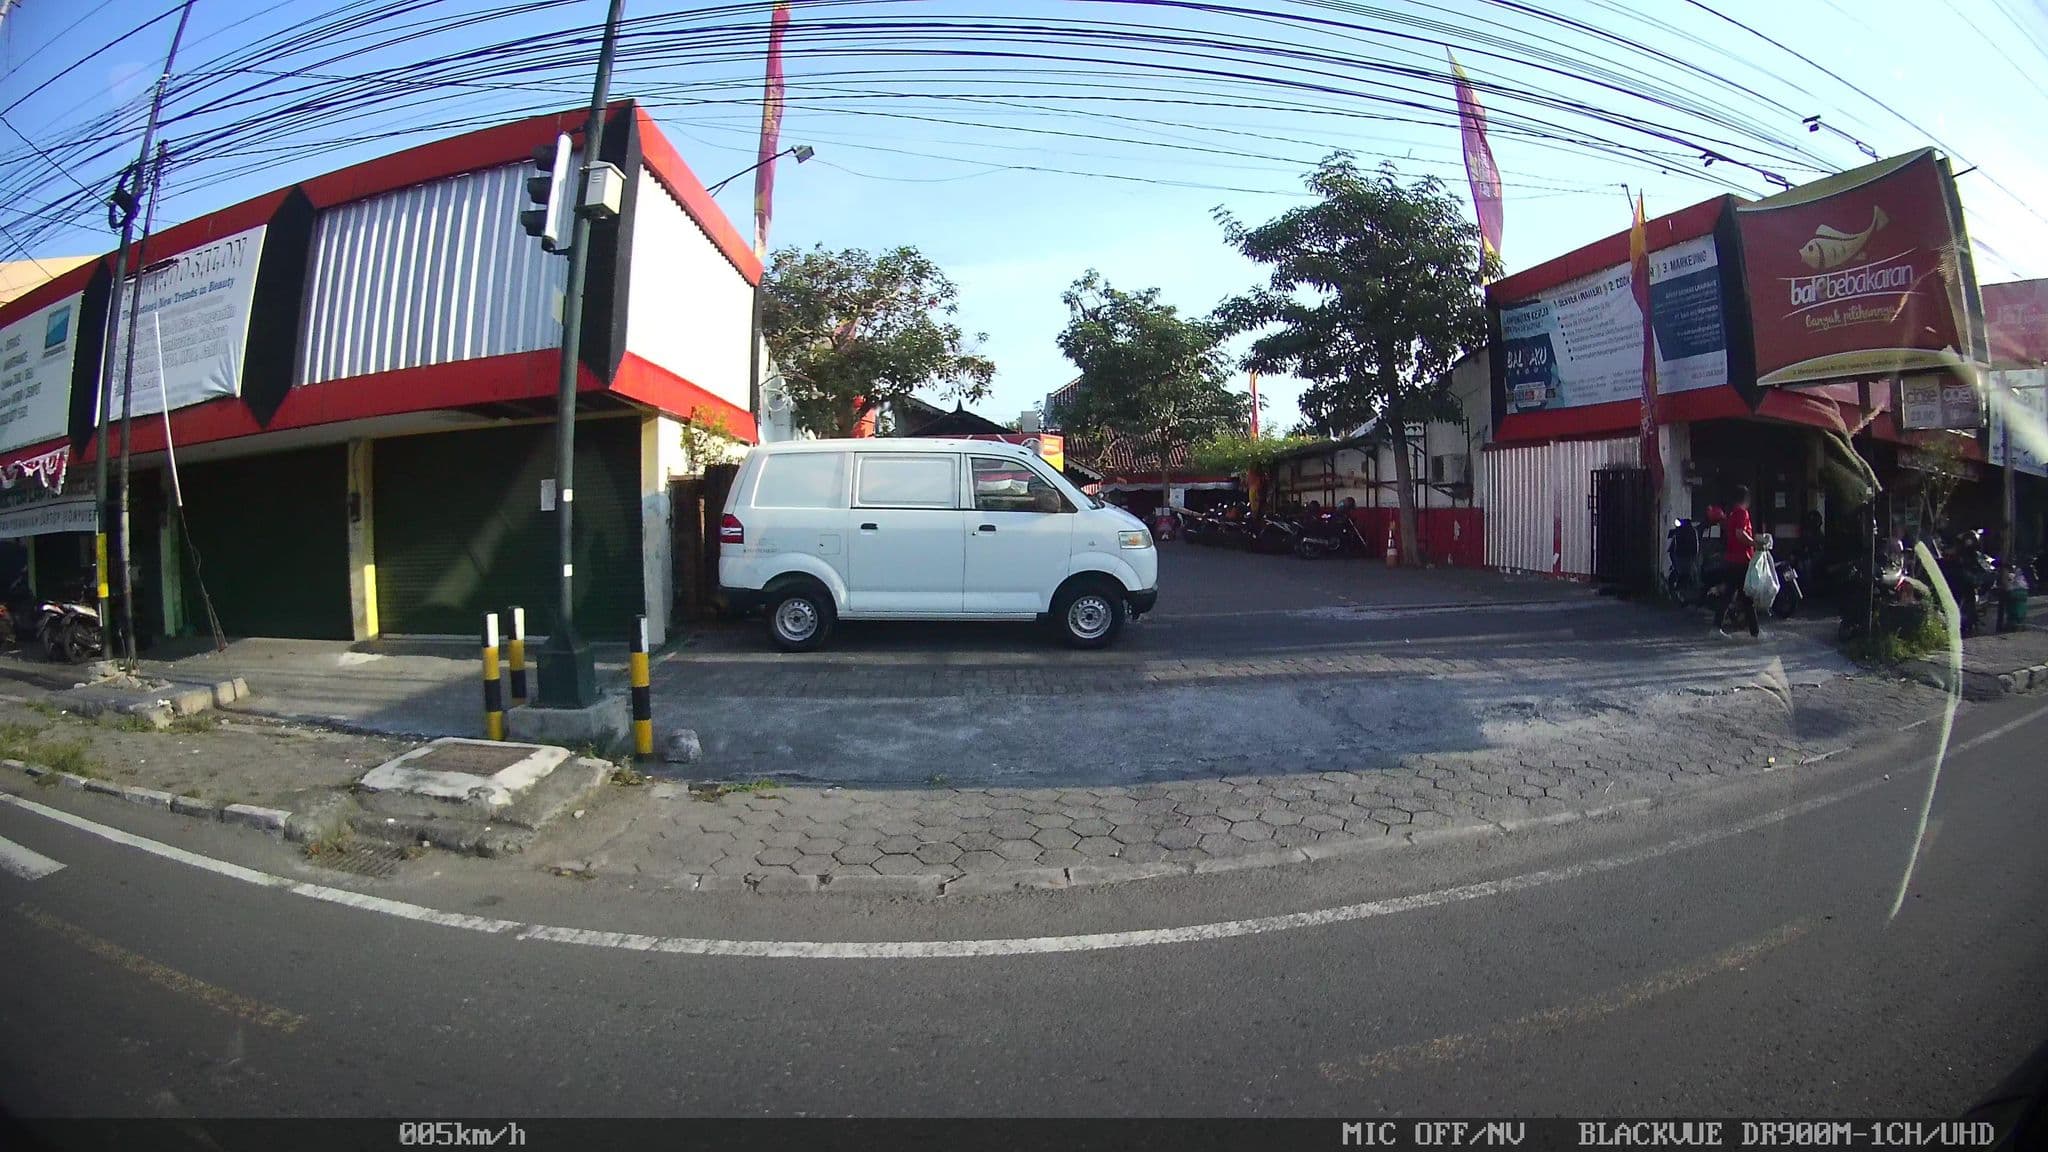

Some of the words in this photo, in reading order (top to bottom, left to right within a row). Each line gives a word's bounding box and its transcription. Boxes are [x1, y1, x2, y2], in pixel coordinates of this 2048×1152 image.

[1670, 249, 1708, 271] MARKETING
[174, 288, 199, 303] Trends
[209, 277, 235, 294] Beauty
